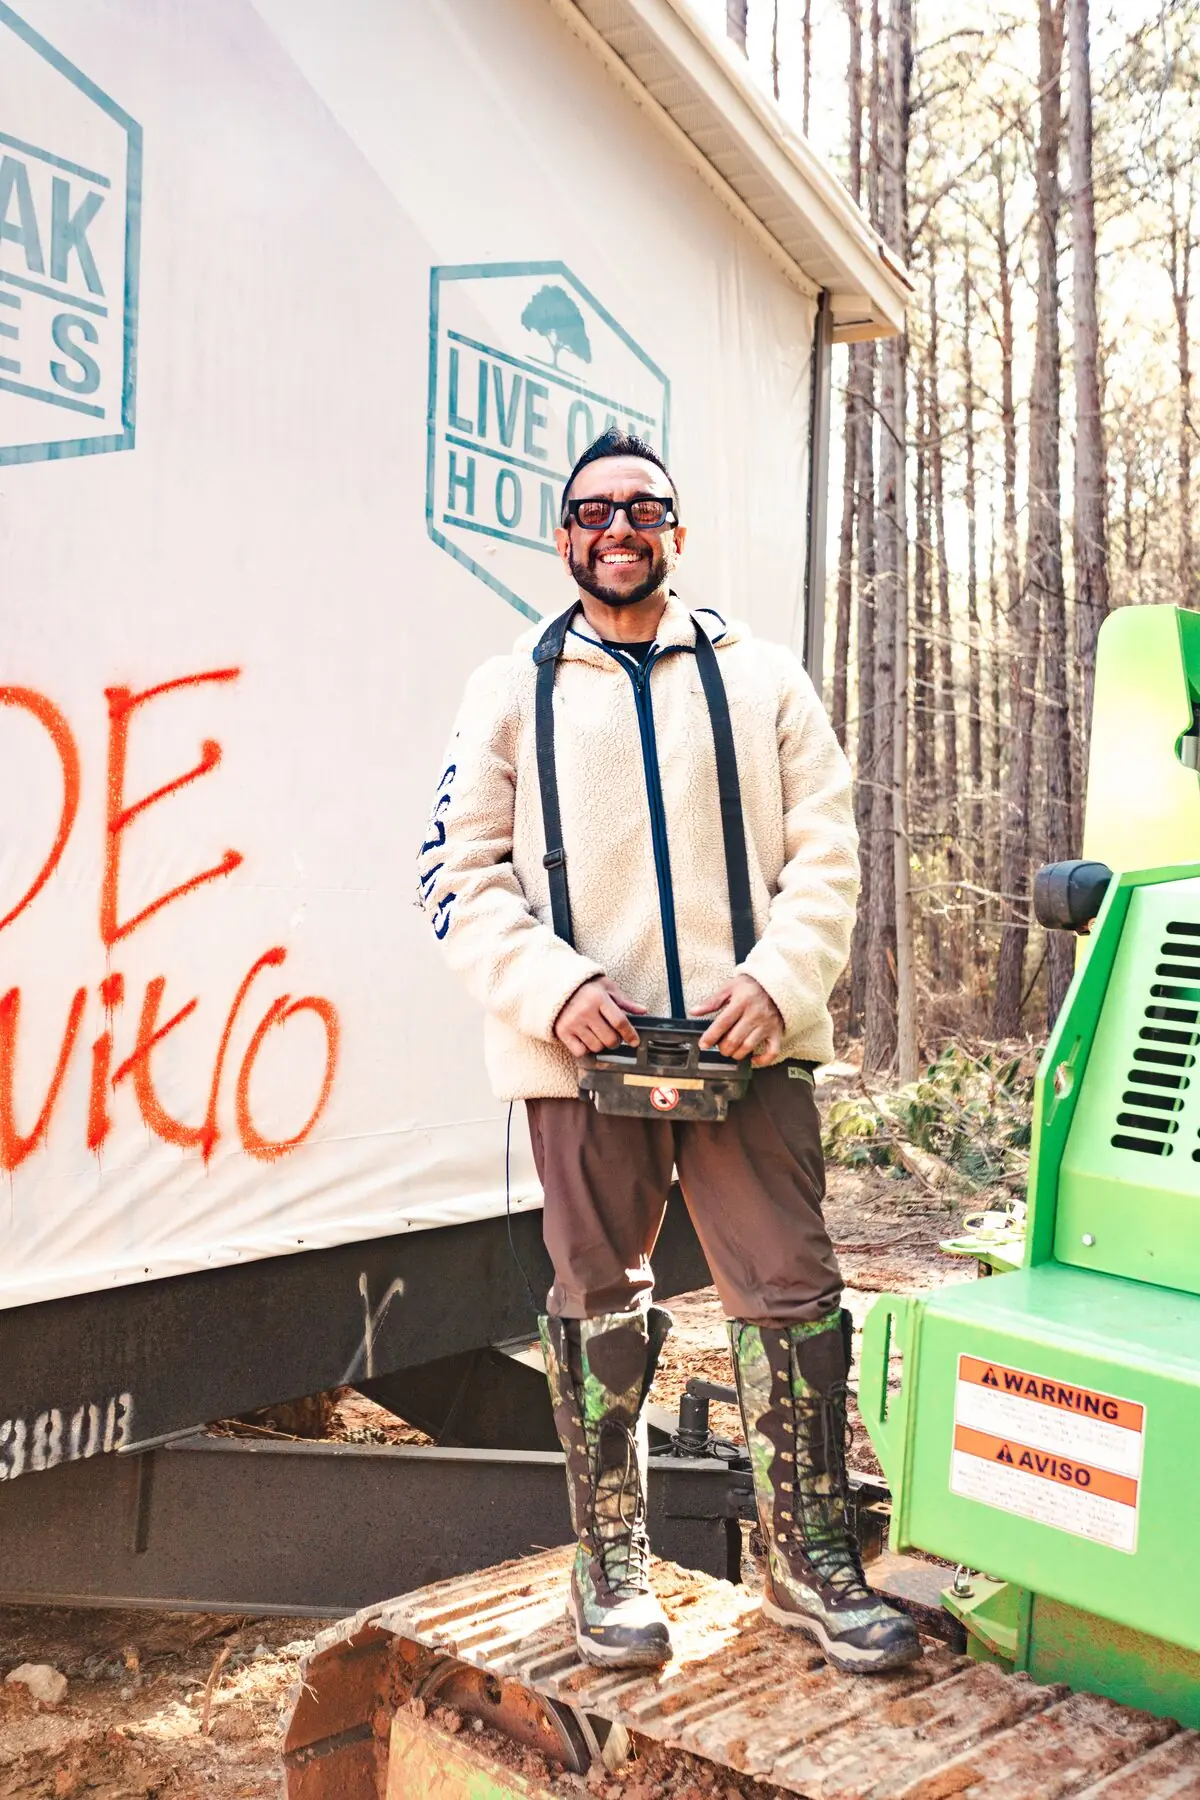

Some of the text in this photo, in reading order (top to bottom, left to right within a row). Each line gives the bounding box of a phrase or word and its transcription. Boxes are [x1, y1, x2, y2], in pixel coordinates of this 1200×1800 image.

[448, 347, 549, 460] LIVE
[1004, 1372, 1118, 1420] WARNING
[1019, 1451, 1091, 1487] AVISO
